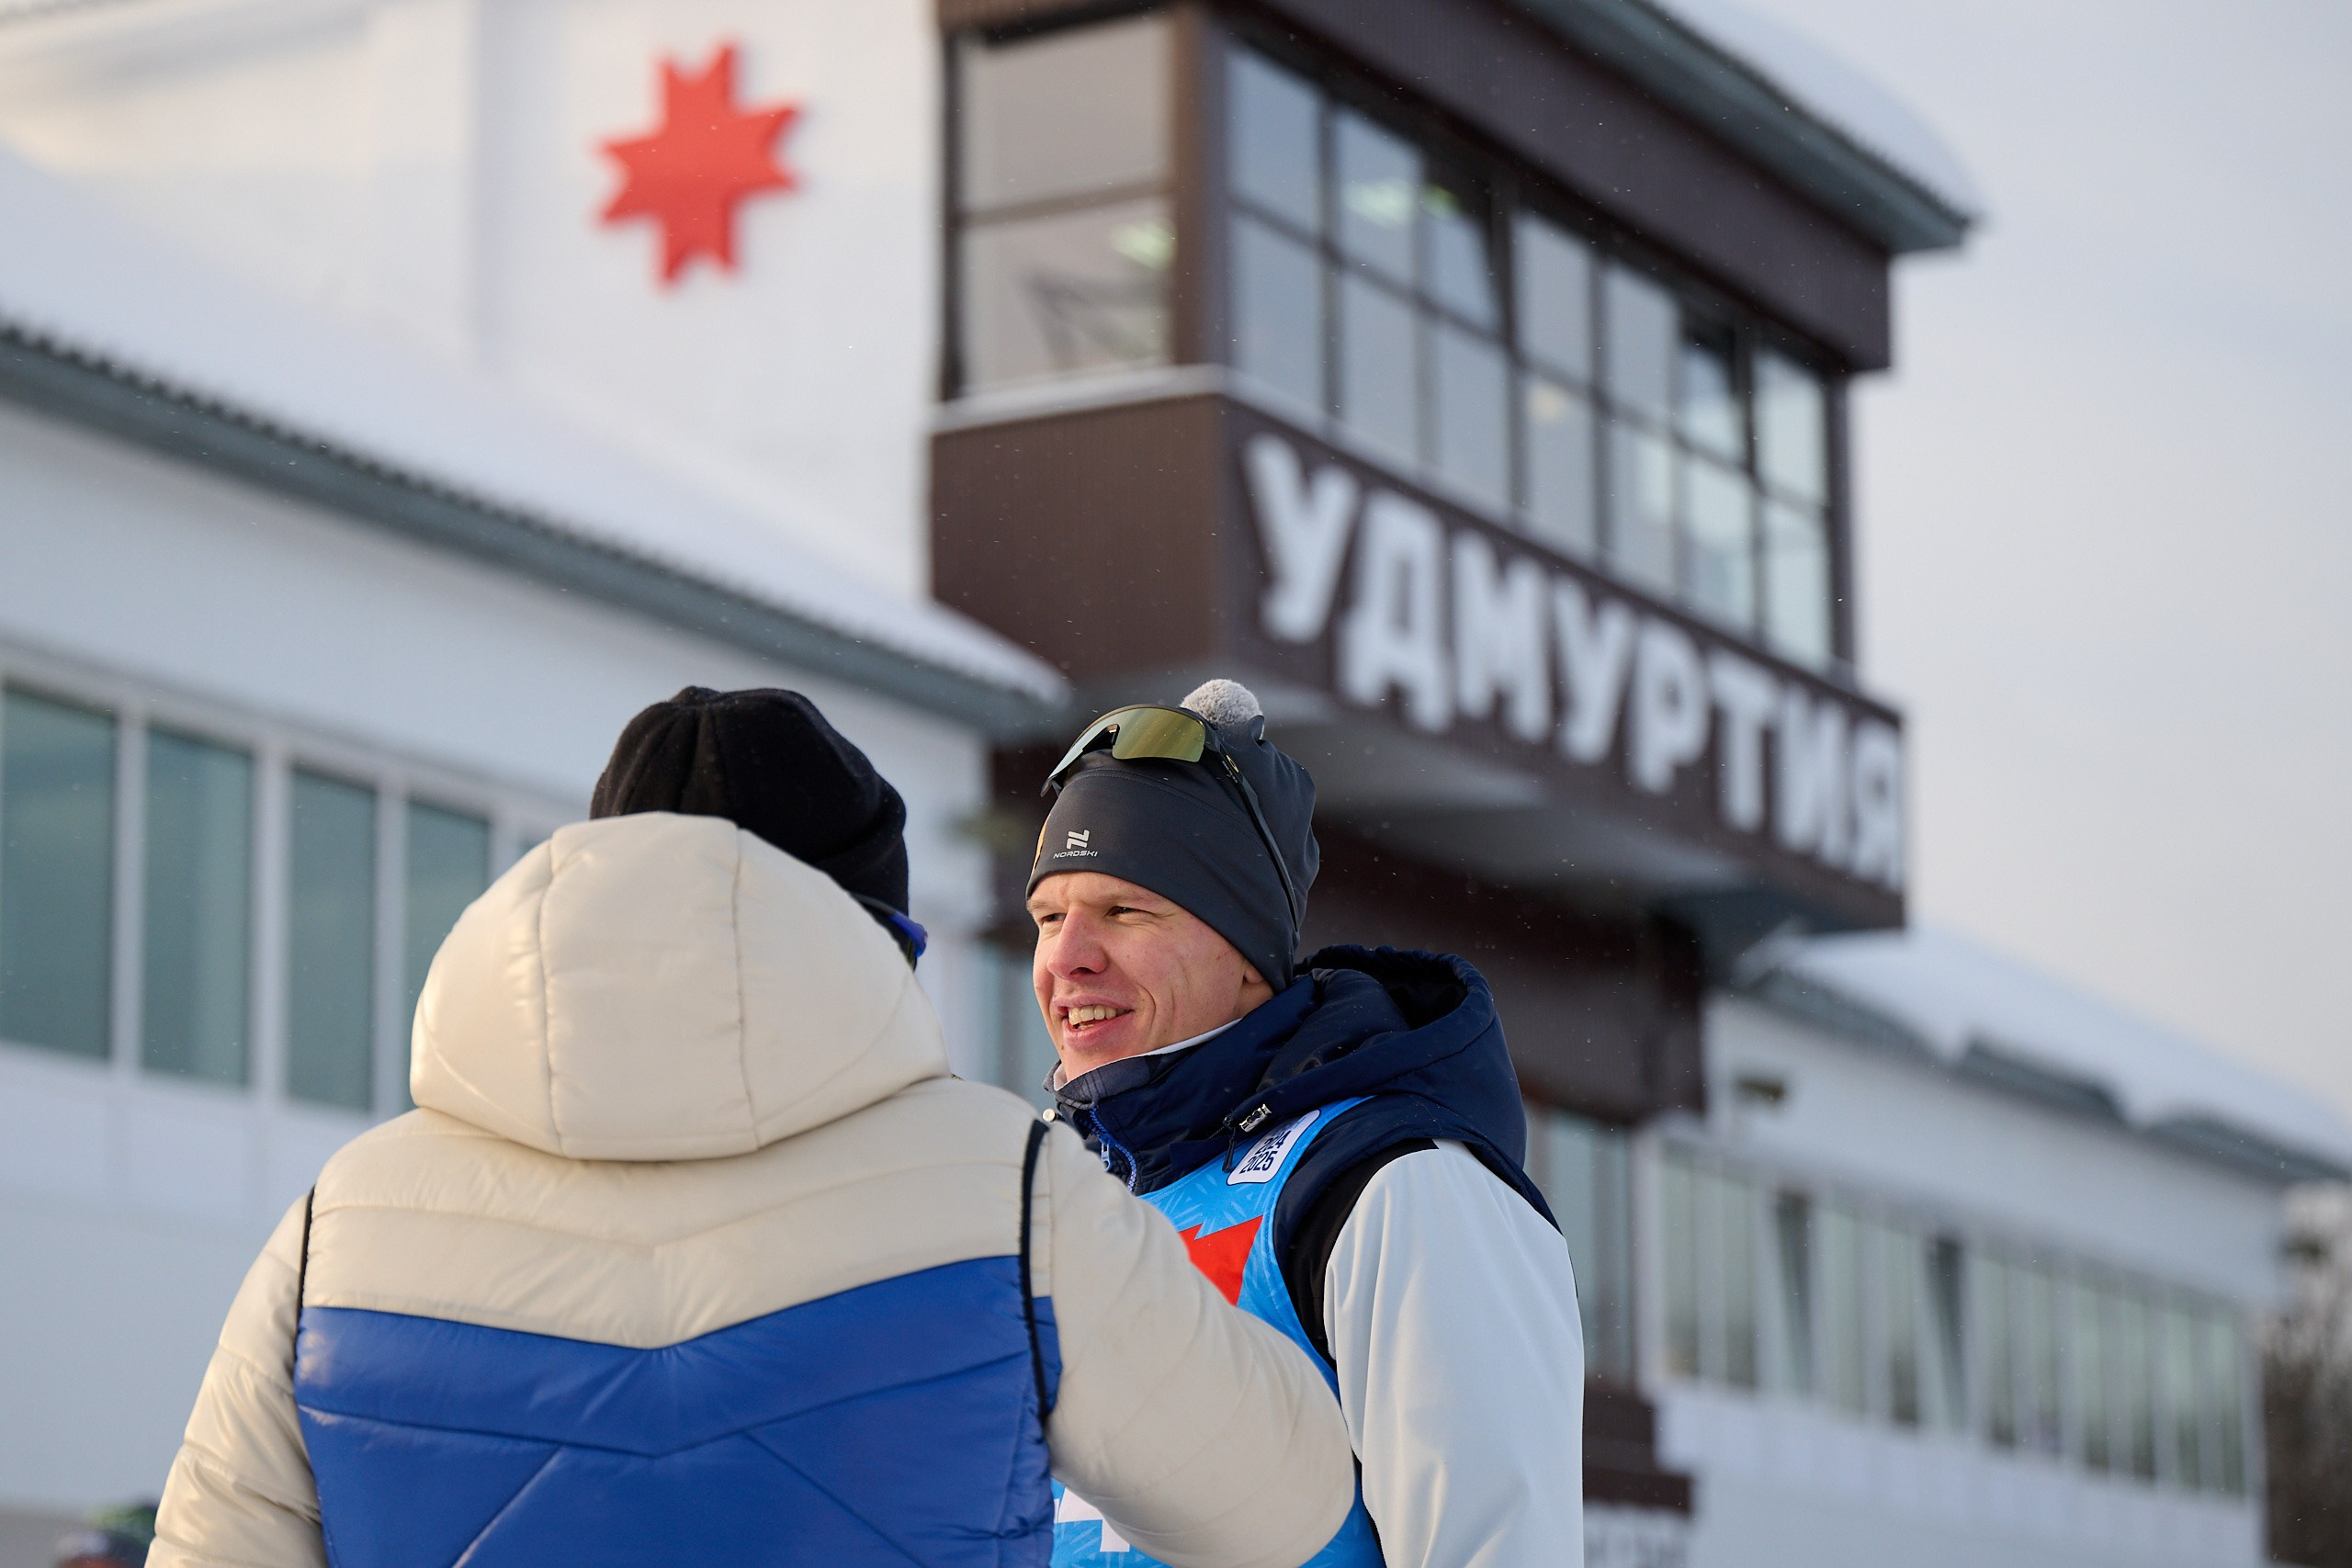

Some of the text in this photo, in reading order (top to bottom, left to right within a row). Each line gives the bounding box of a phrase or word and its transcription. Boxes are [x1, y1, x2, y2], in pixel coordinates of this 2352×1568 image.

[1244, 432, 1905, 889] УДМУРТИЯ
[1053, 850, 1098, 859] NORDSKI
[1239, 1150, 1278, 1174] 2025
